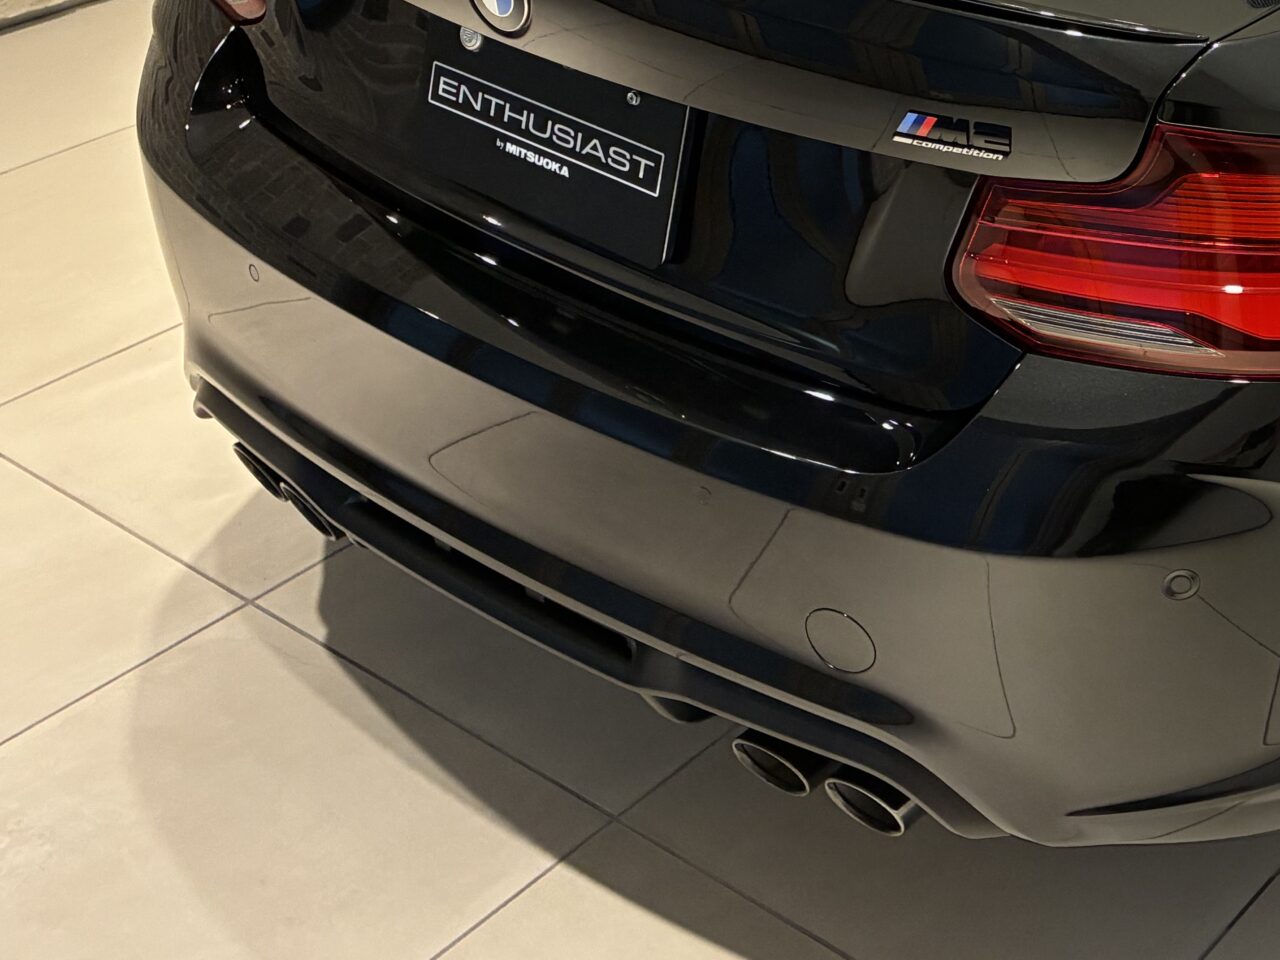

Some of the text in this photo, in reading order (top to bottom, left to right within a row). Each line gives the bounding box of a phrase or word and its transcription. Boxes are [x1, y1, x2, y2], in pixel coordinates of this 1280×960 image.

[437, 76, 655, 179] ENTHUSIAST
[496, 138, 570, 178] by MITSUOKA
[912, 139, 1004, 161] competition
